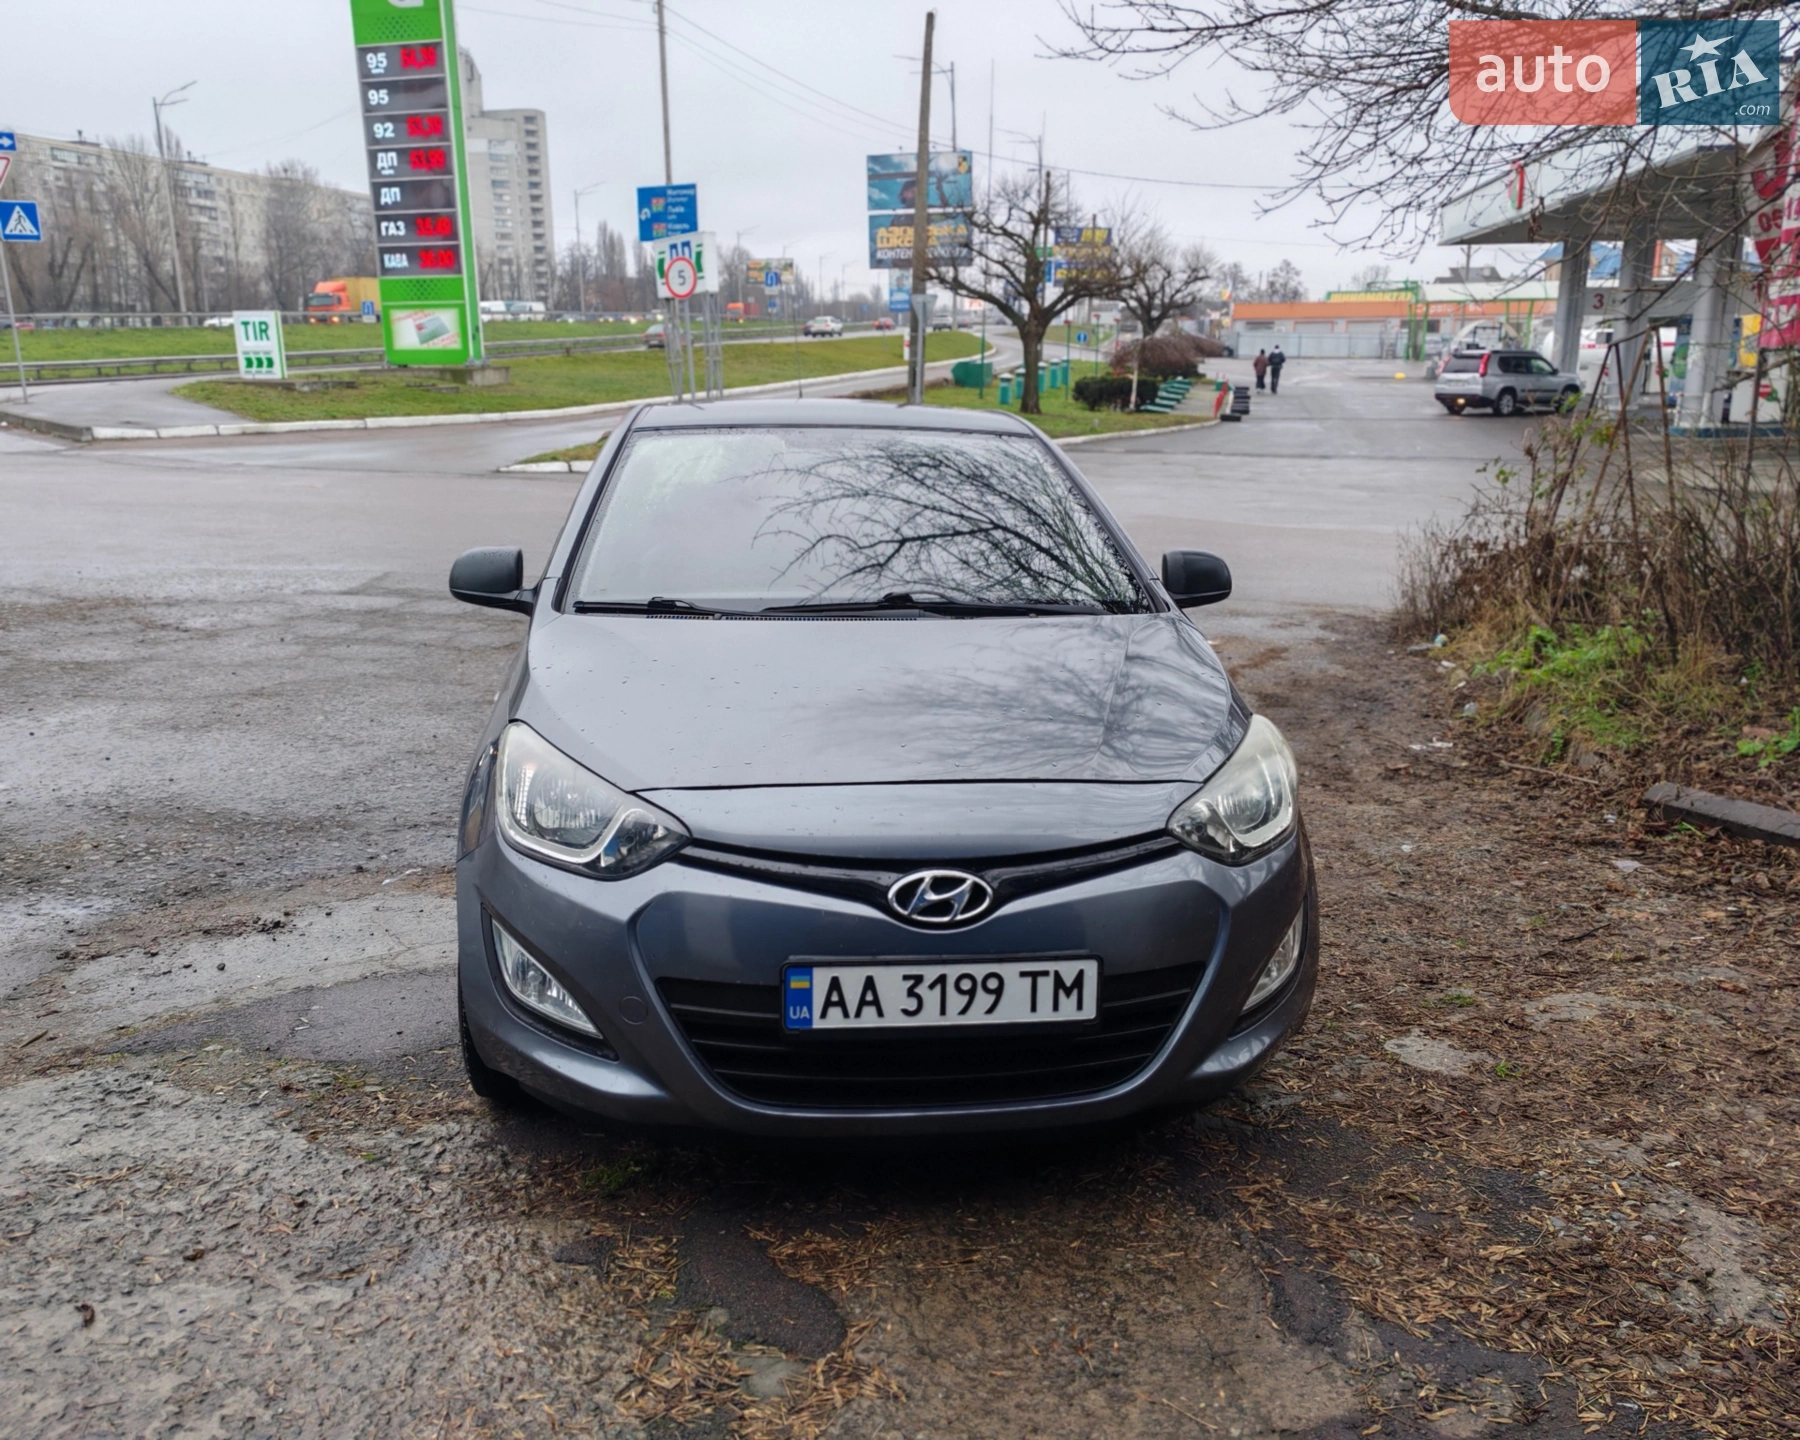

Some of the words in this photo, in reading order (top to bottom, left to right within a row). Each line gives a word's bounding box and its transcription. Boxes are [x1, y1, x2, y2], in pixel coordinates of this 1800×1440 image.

[366, 52, 388, 69] 95
[368, 89, 389, 105] 95
[373, 122, 395, 138] 92
[377, 151, 398, 170] ДП
[380, 187, 401, 205] ДП
[380, 221, 406, 236] ГАЗ
[677, 269, 687, 286] 5
[1593, 293, 1604, 310] 3
[241, 320, 270, 341] TIR
[819, 974, 884, 1019] AA
[900, 971, 1005, 1017] 3199
[1019, 968, 1085, 1013] TM
[789, 1006, 810, 1019] UA
